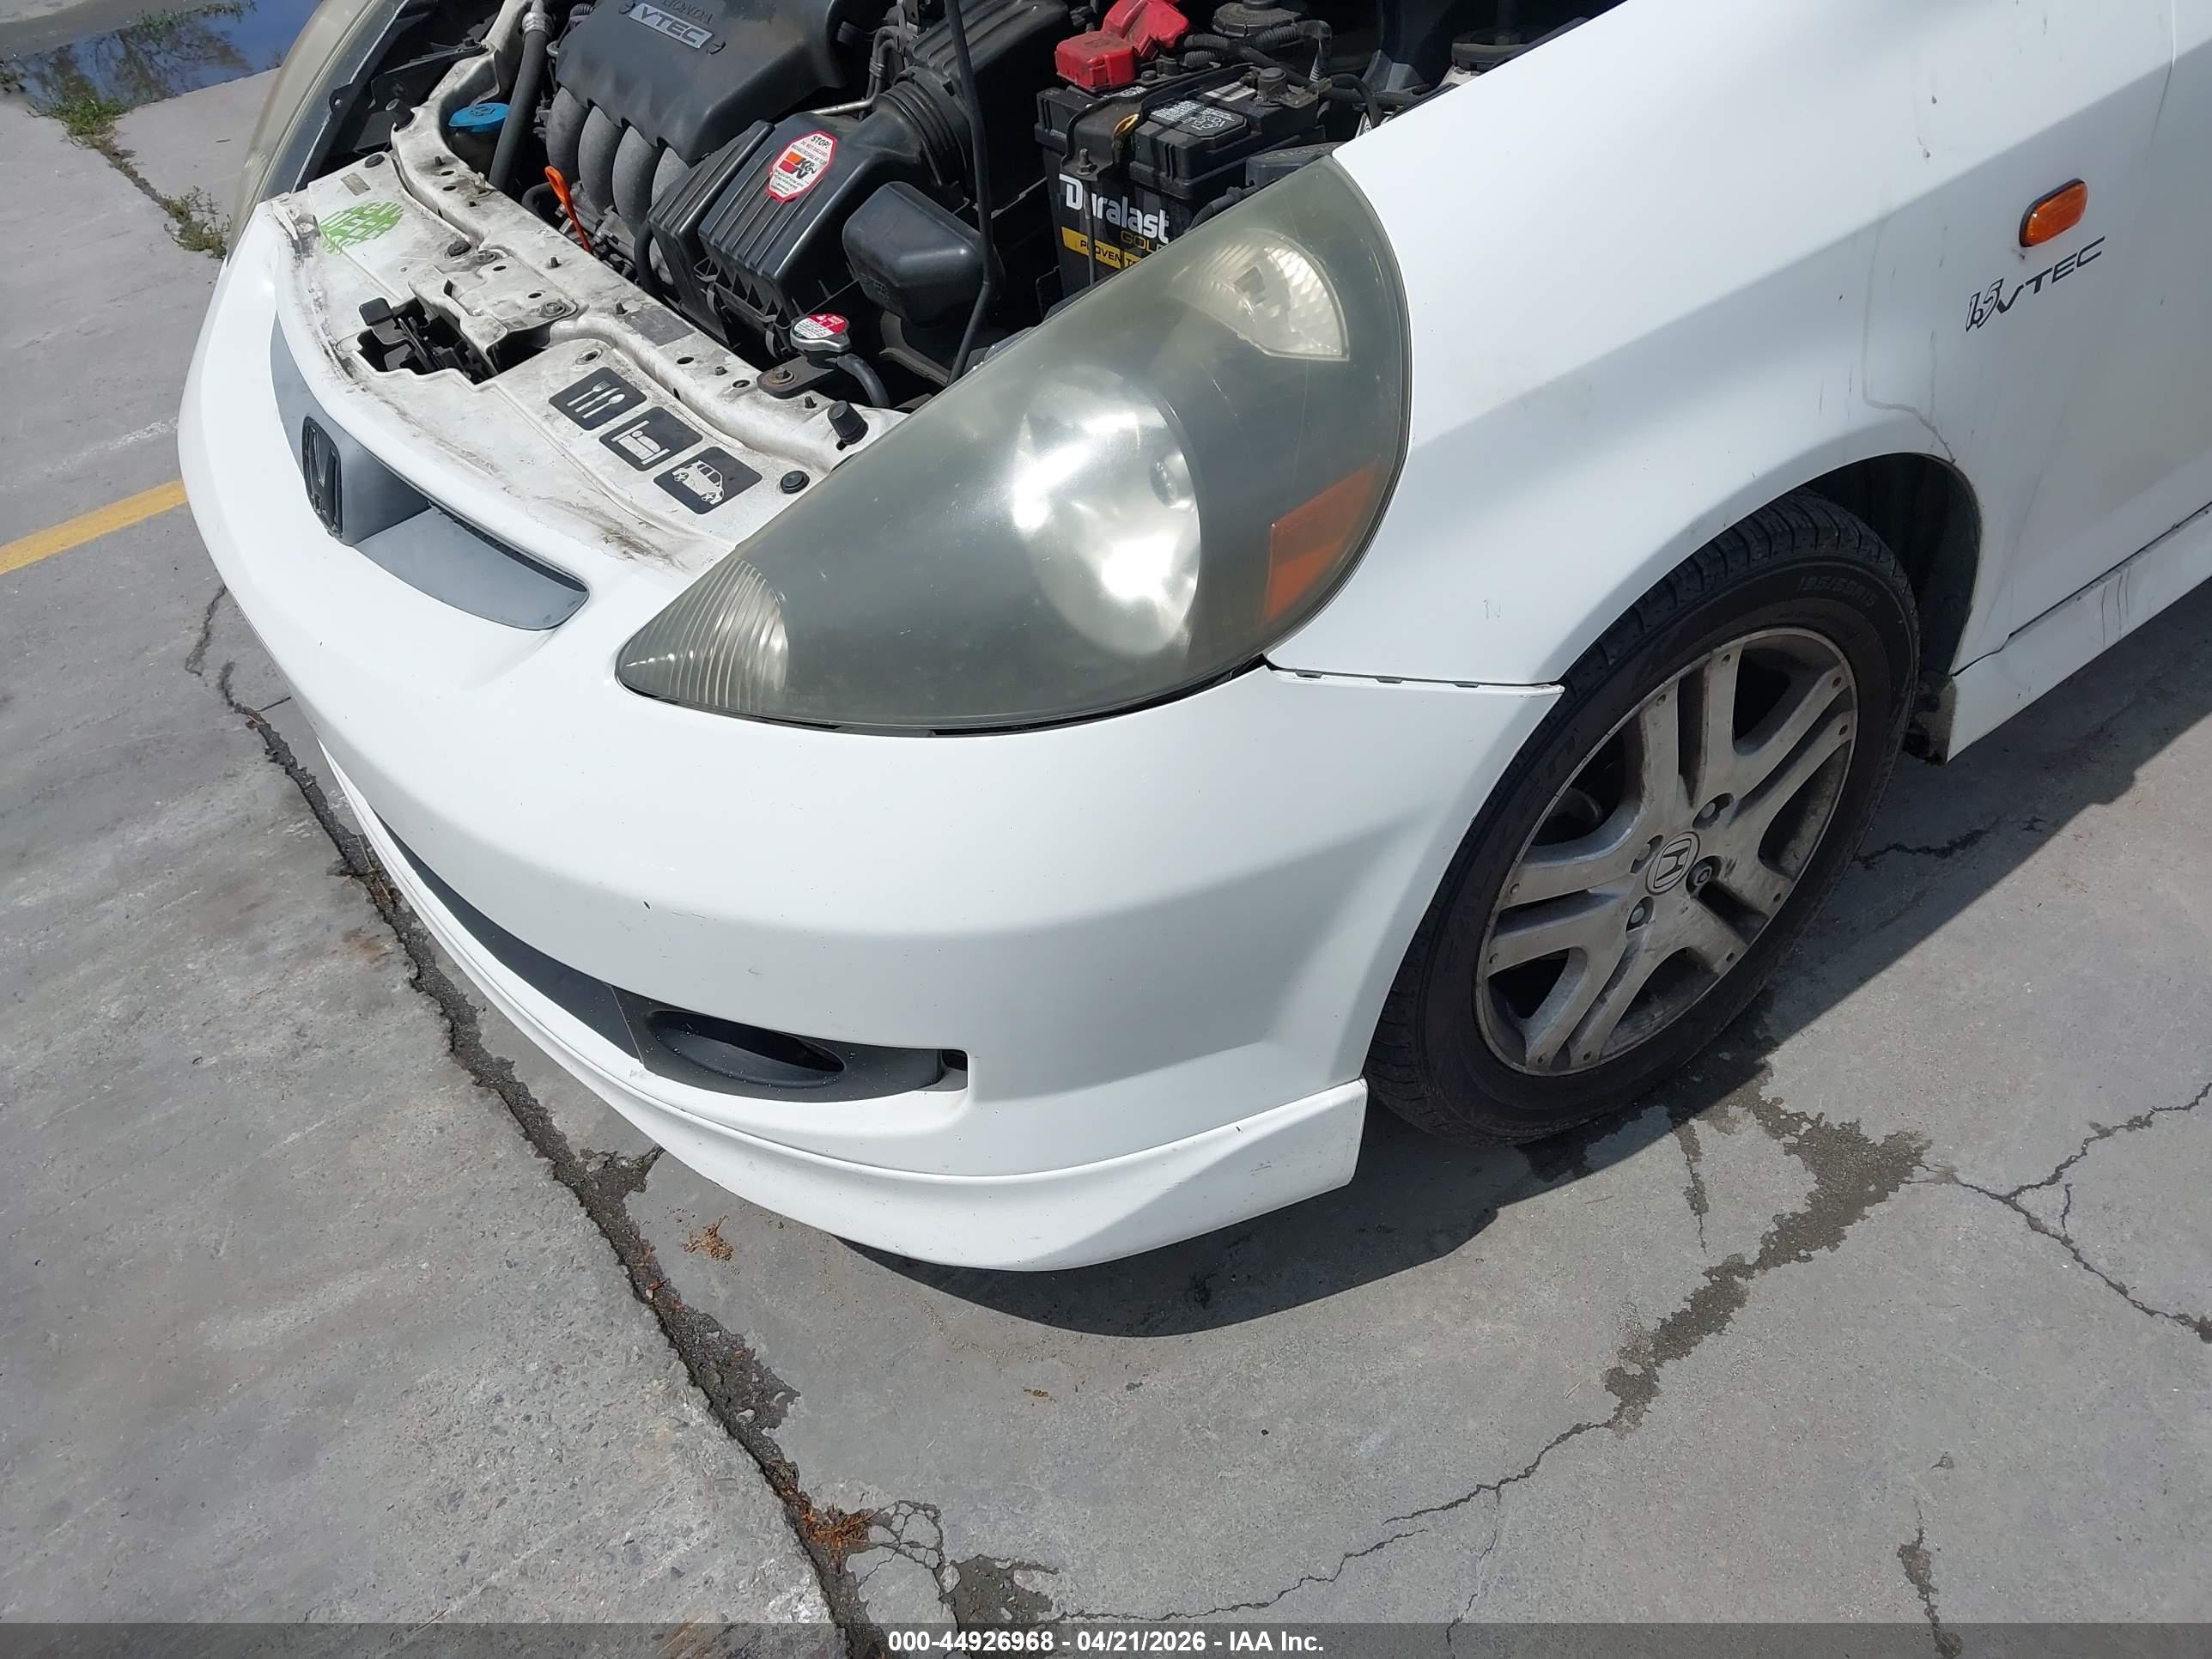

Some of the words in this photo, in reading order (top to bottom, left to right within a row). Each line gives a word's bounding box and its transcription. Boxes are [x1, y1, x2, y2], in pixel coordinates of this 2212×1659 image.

[641, 5, 704, 44] VTEC
[810, 135, 831, 149] STOP!
[1079, 240, 1122, 264] POVEN
